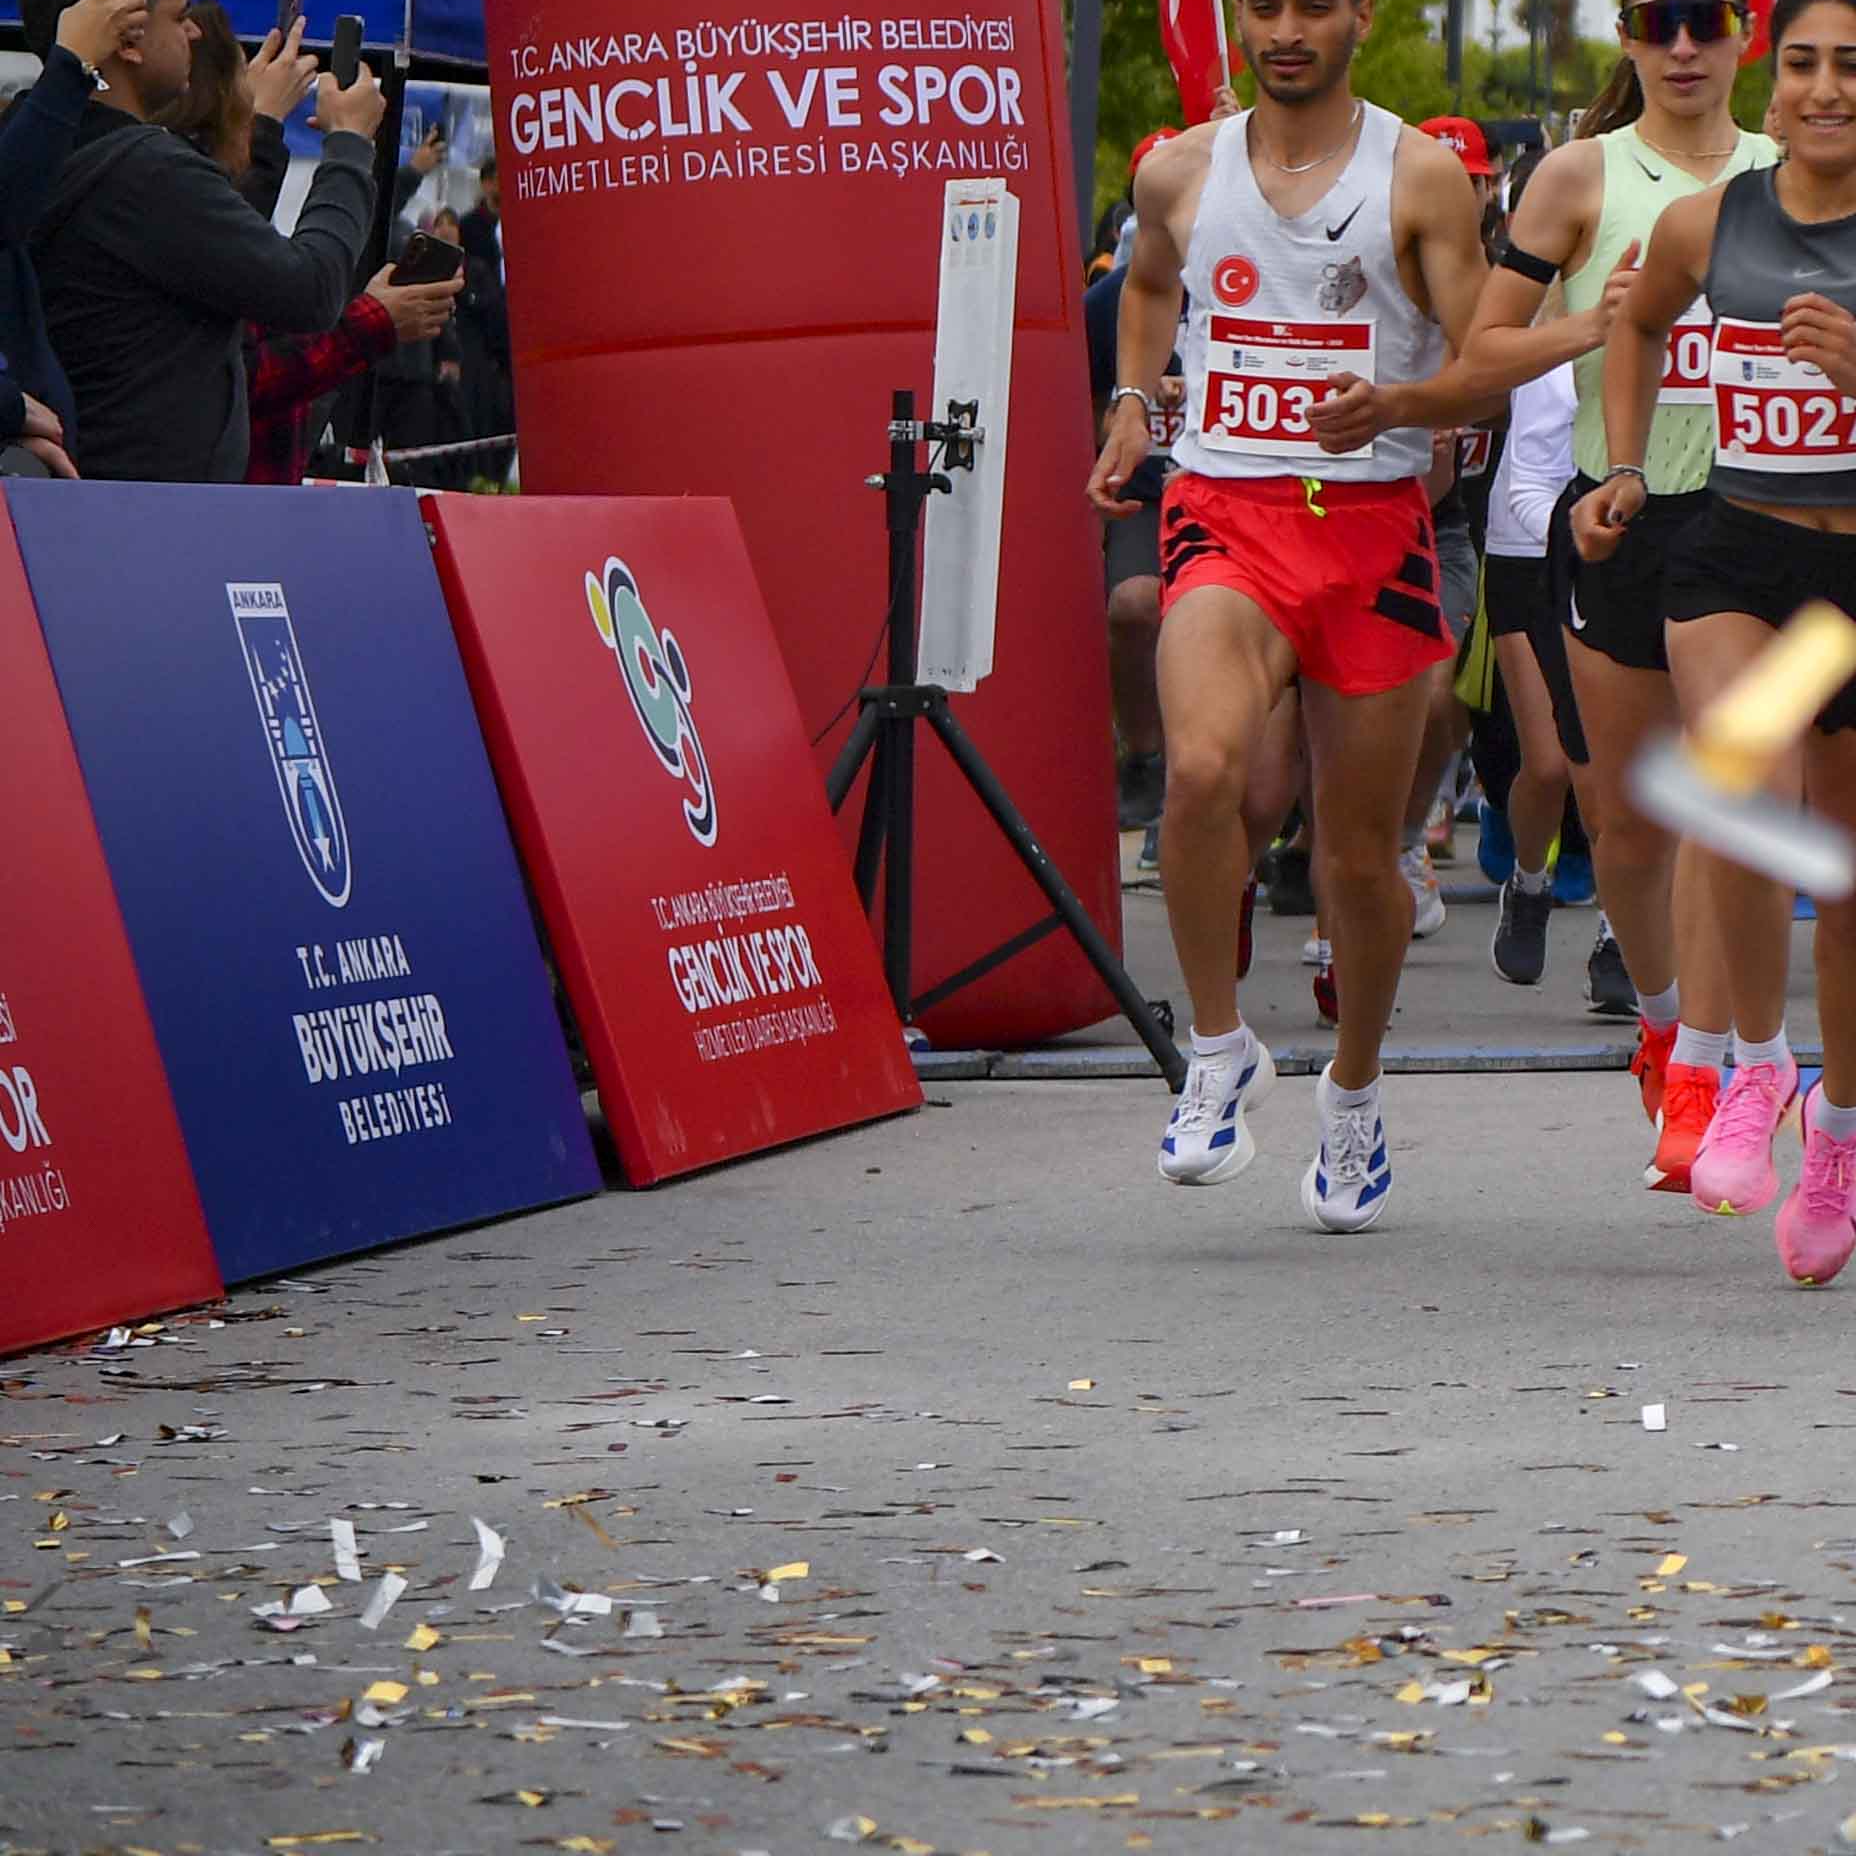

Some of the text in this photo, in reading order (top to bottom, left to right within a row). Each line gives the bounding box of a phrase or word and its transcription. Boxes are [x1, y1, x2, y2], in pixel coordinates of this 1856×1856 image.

[511, 15, 1015, 80] T.C. ANKARA BÜYÜKŞEHİR BELEDİYESİ
[510, 61, 1025, 155] GENÇLİK VE SPOR
[517, 135, 1029, 201] HİZMETLERİ DAİRESİ BAŞKANLIĞI
[1219, 380, 1338, 433] 503
[296, 934, 411, 989] T.C. ANKARA
[738, 930, 779, 997] VE
[762, 921, 821, 992] SPOR
[292, 993, 454, 1084] BÜYÜKŞEHİR
[338, 1082, 452, 1145] BELEDİYESİ
